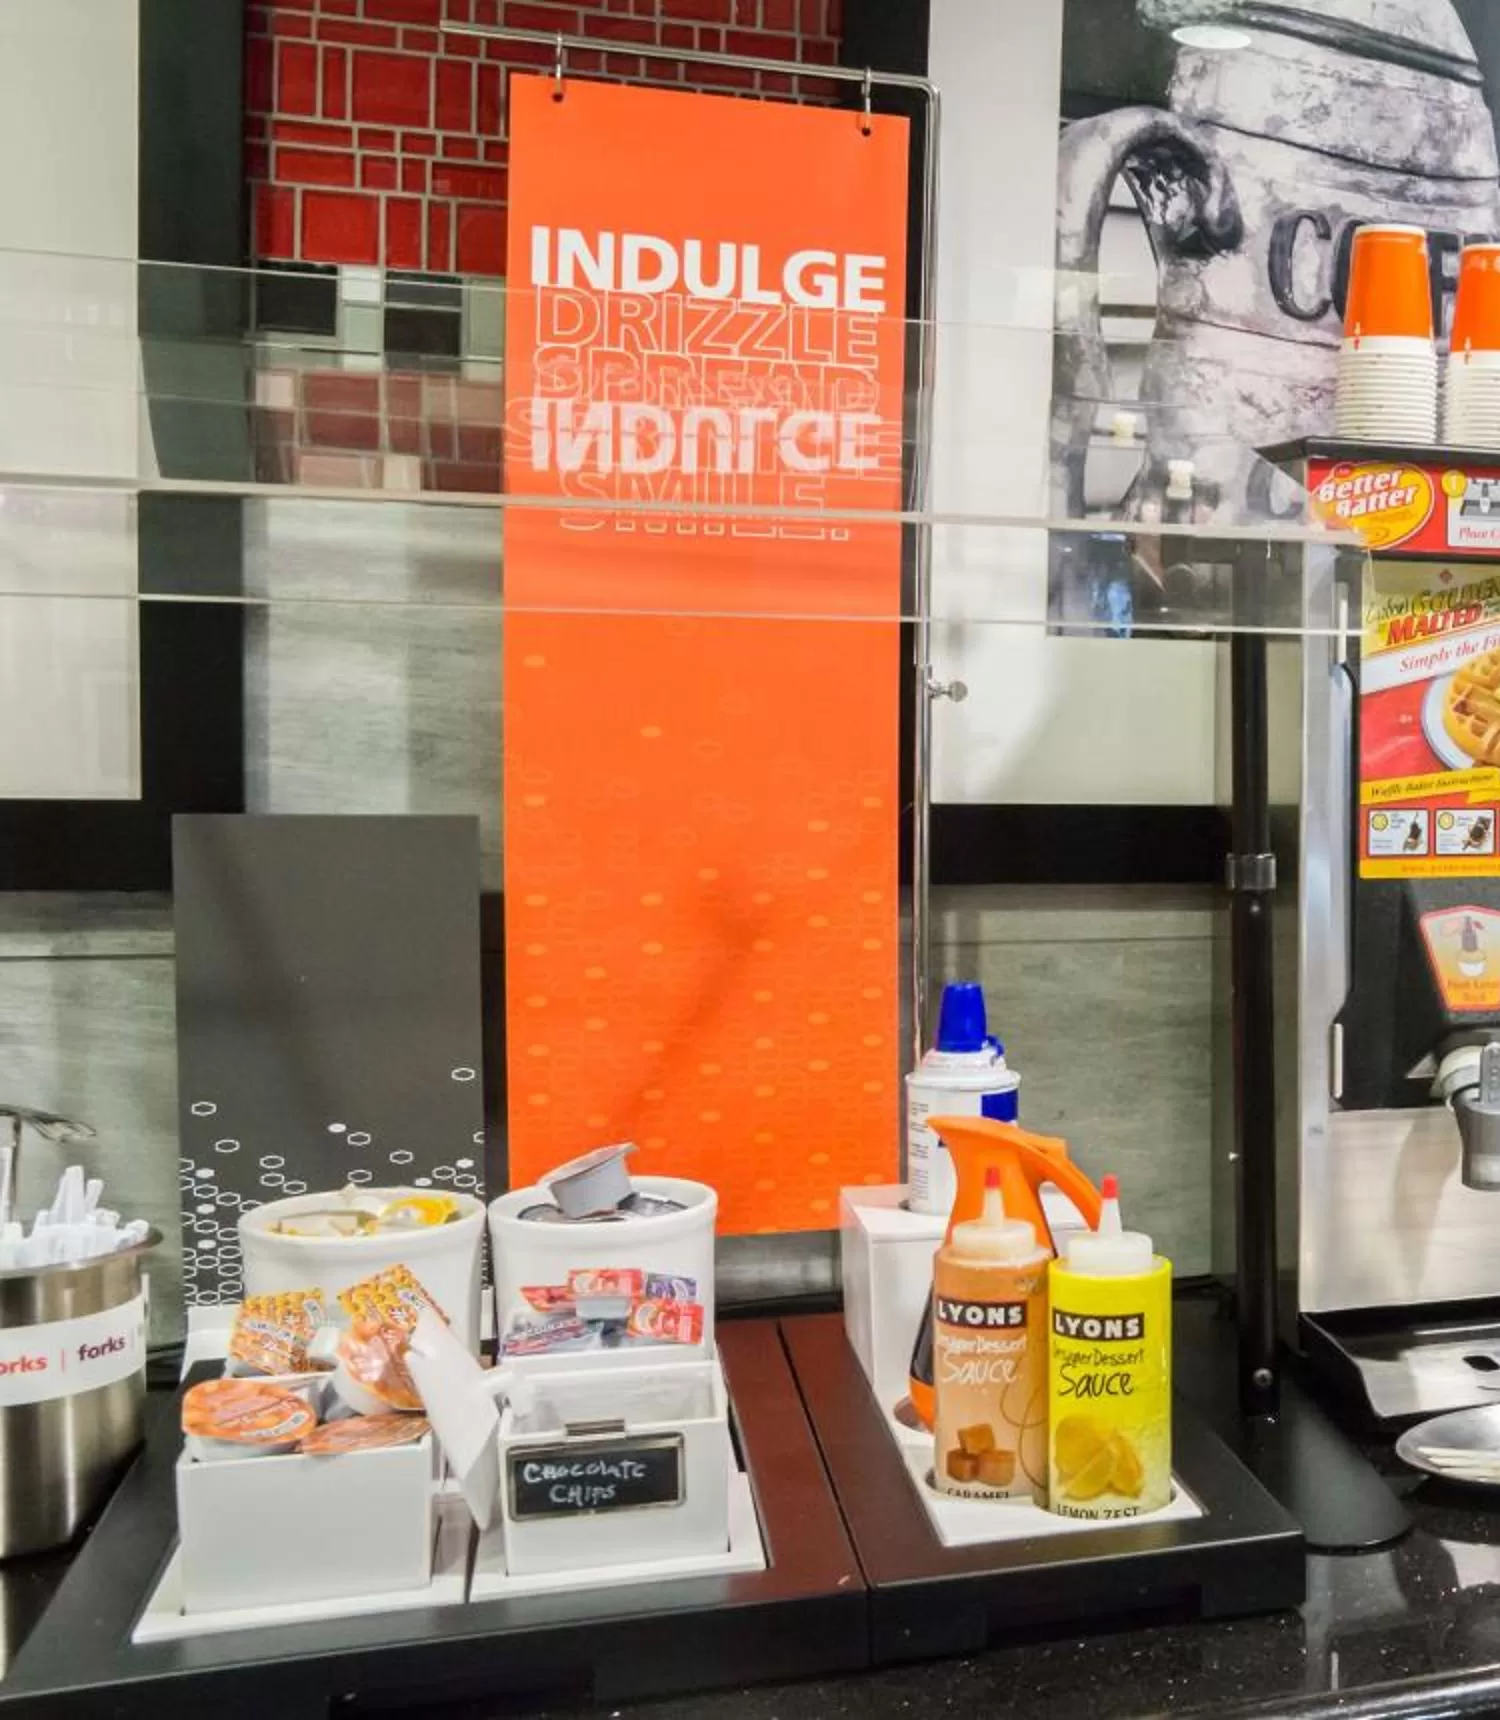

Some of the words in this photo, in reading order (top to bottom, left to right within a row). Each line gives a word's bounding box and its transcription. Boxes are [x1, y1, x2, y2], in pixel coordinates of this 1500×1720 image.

[530, 225, 886, 313] INDULGE
[535, 284, 878, 369] DRIZZLE
[1318, 469, 1403, 502] Better
[1334, 484, 1420, 519] Batter
[1387, 602, 1483, 646] MALTED
[1400, 648, 1453, 673] Simply
[1455, 641, 1480, 658] the
[938, 1300, 1024, 1327] LYONS
[1054, 1312, 1141, 1340] LYONS
[0, 1356, 48, 1375] orks
[77, 1336, 126, 1362] forks
[940, 1350, 1018, 1386] Sauce
[1057, 1362, 1135, 1398] Sauce
[549, 1483, 618, 1507] CHIPS
[1056, 1503, 1099, 1521] LEMON
